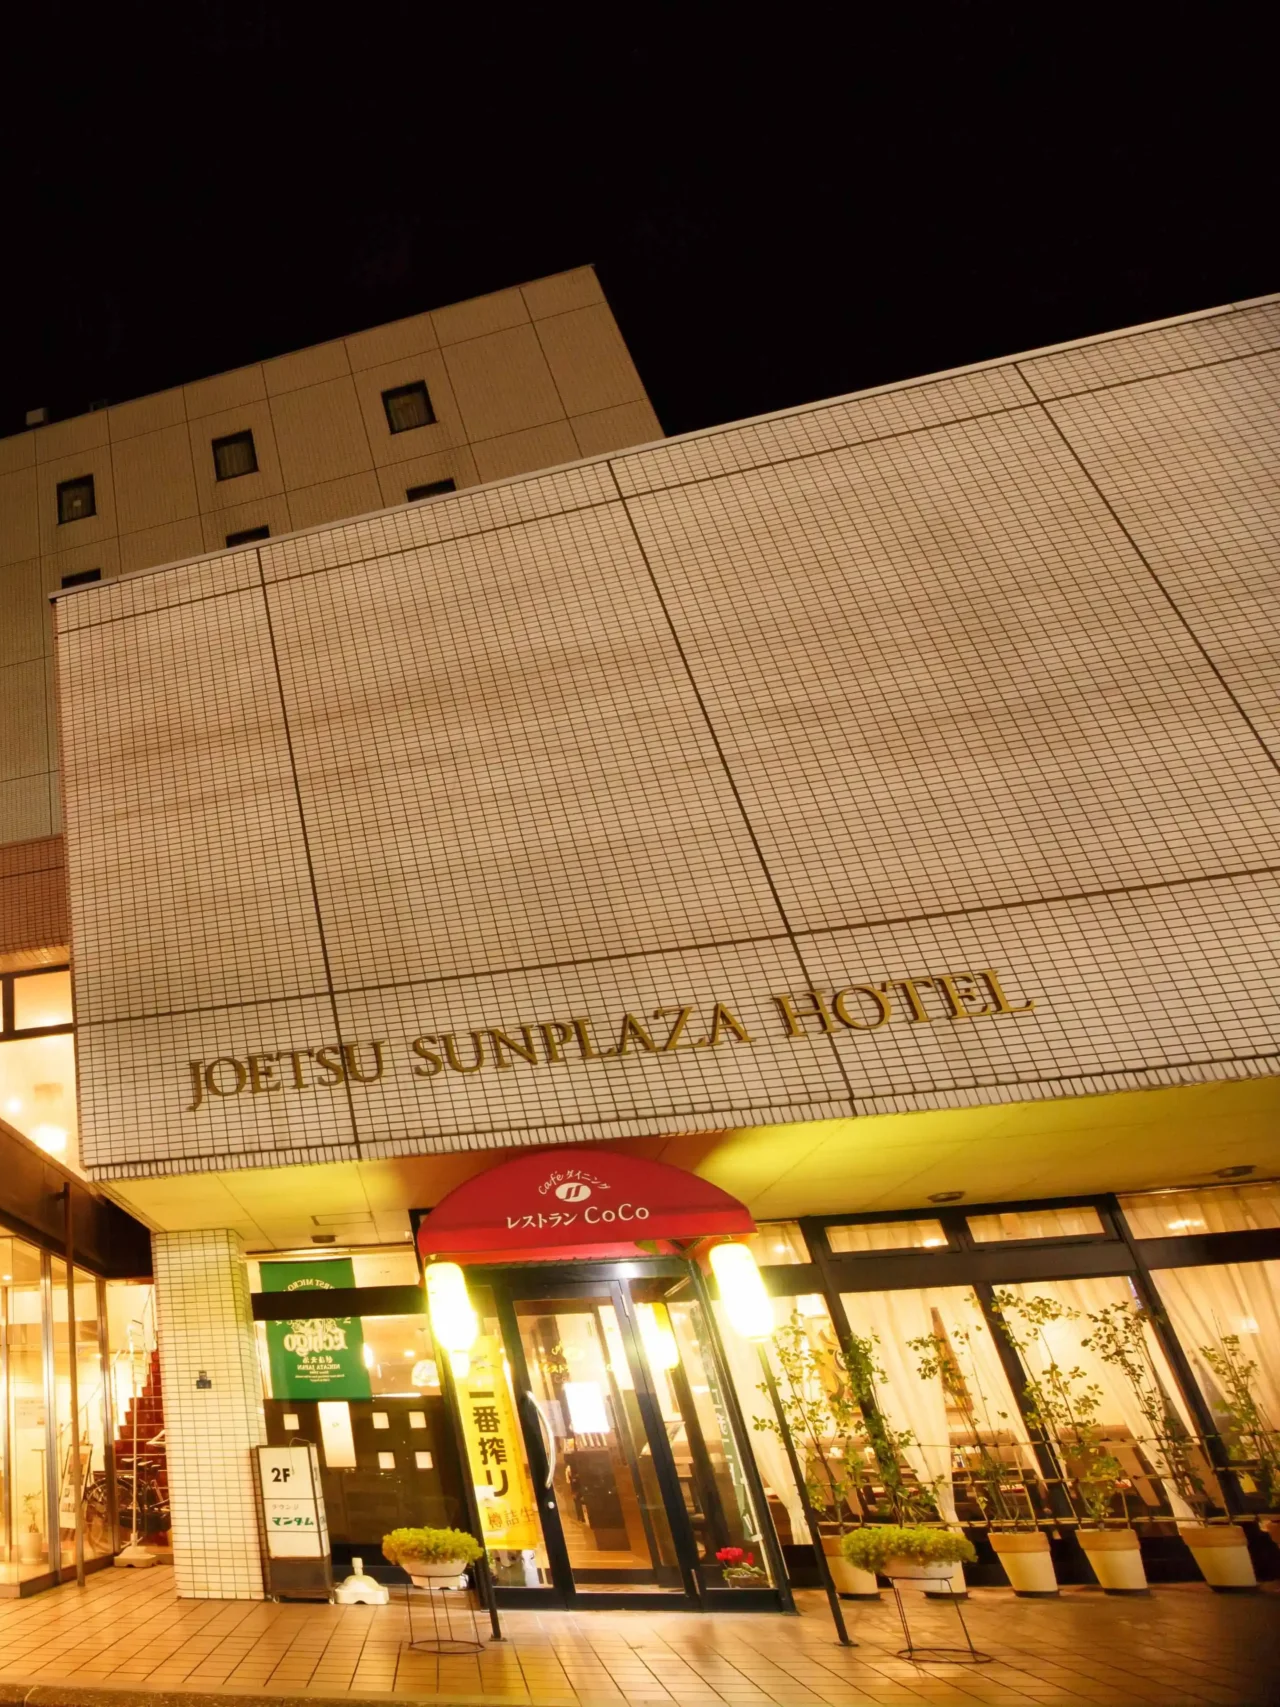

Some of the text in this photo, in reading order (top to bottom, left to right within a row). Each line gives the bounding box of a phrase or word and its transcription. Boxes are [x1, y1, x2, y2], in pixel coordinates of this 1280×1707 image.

[186, 969, 1036, 1112] JOETSU SUNPLAZA HOTEL
[566, 1169, 611, 1190] ダイニング
[506, 1203, 650, 1229] レストラン CoCo
[468, 1391, 509, 1498] 一番搾り
[271, 1467, 291, 1483] 2F
